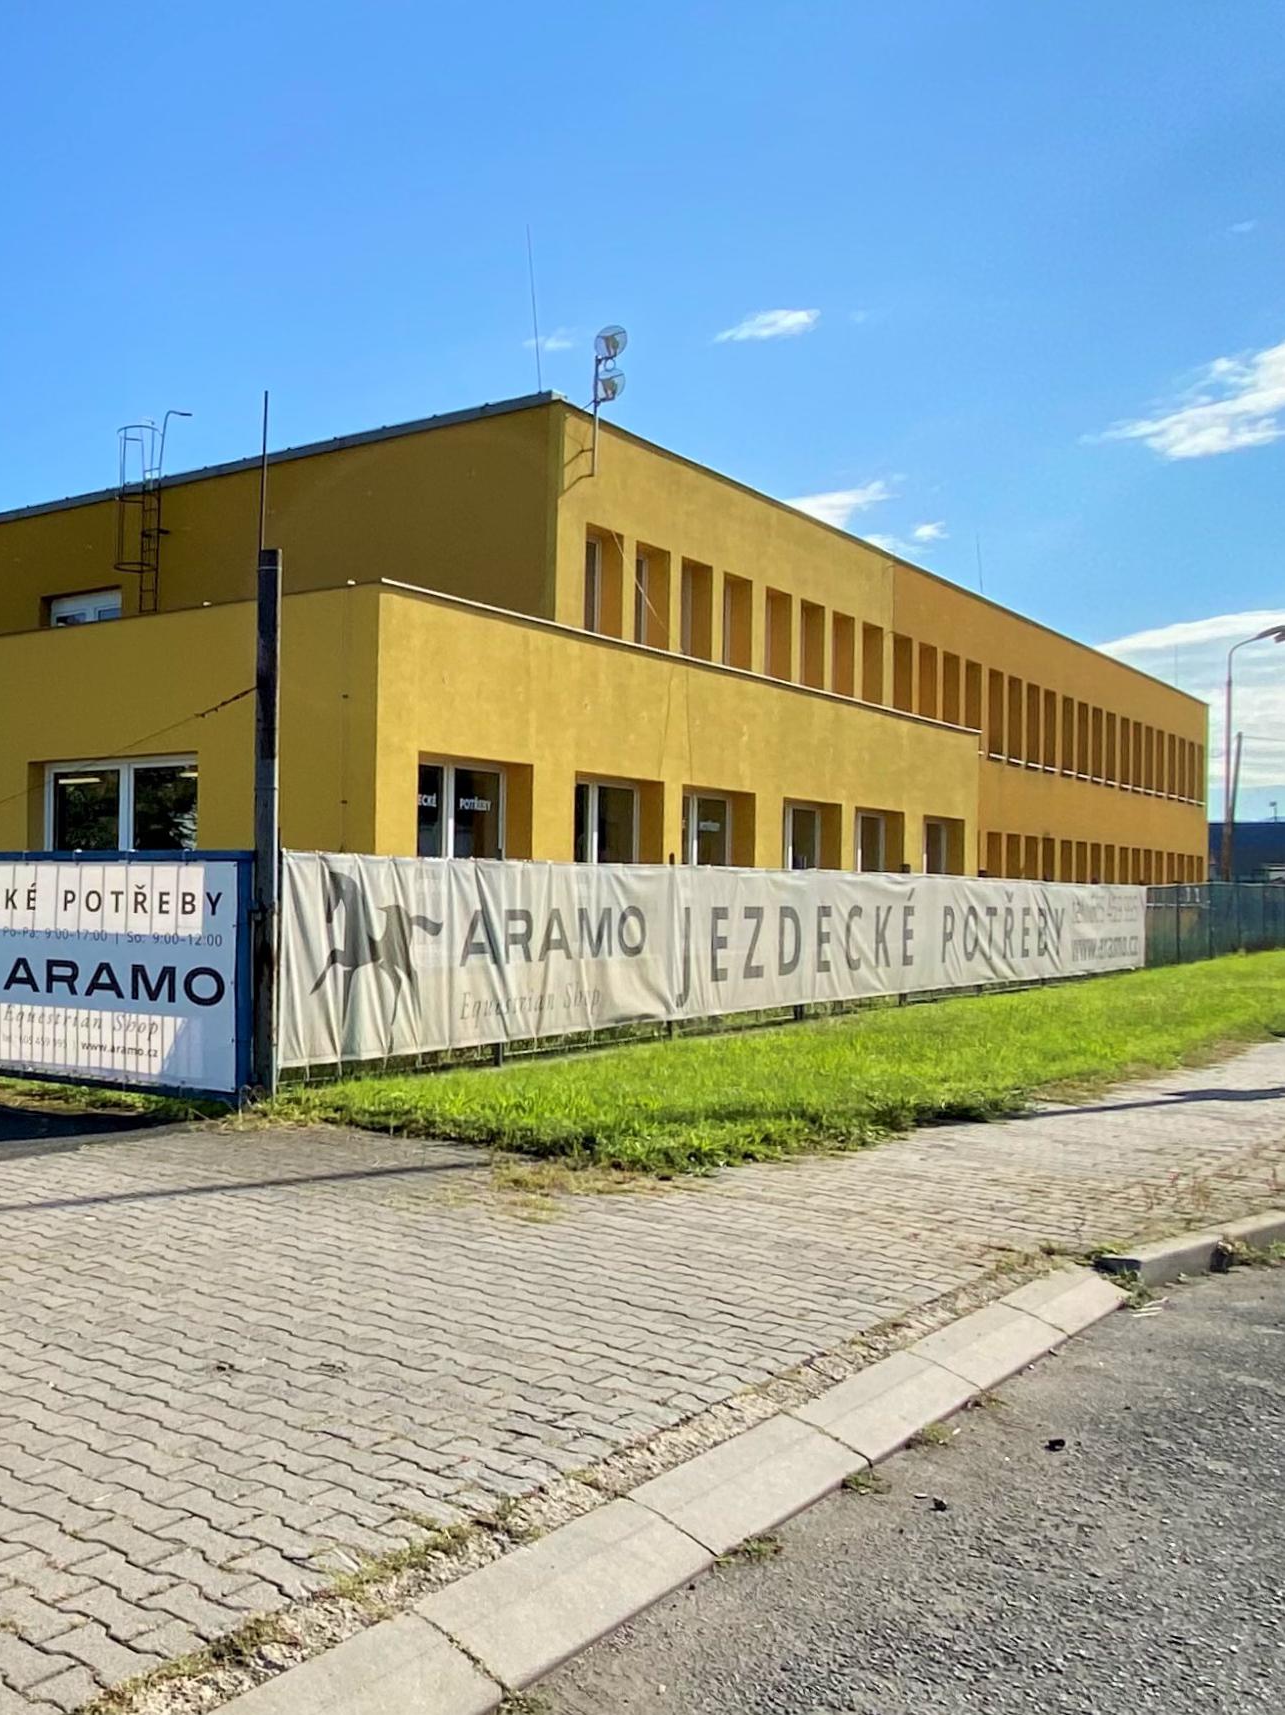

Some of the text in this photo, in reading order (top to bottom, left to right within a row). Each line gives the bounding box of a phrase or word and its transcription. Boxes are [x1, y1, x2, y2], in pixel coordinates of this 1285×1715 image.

[63, 884, 224, 916] POTŘEBY
[152, 932, 223, 948] 9:00-12:00
[460, 905, 647, 967] ARAMO
[676, 888, 915, 1008] JEZDECKÉ
[941, 890, 1065, 963] POTŘEBY
[3, 957, 225, 1007] ARAMO
[3, 1004, 159, 1041] Equestrian Shop
[81, 1041, 158, 1058] www.aramo.cz
